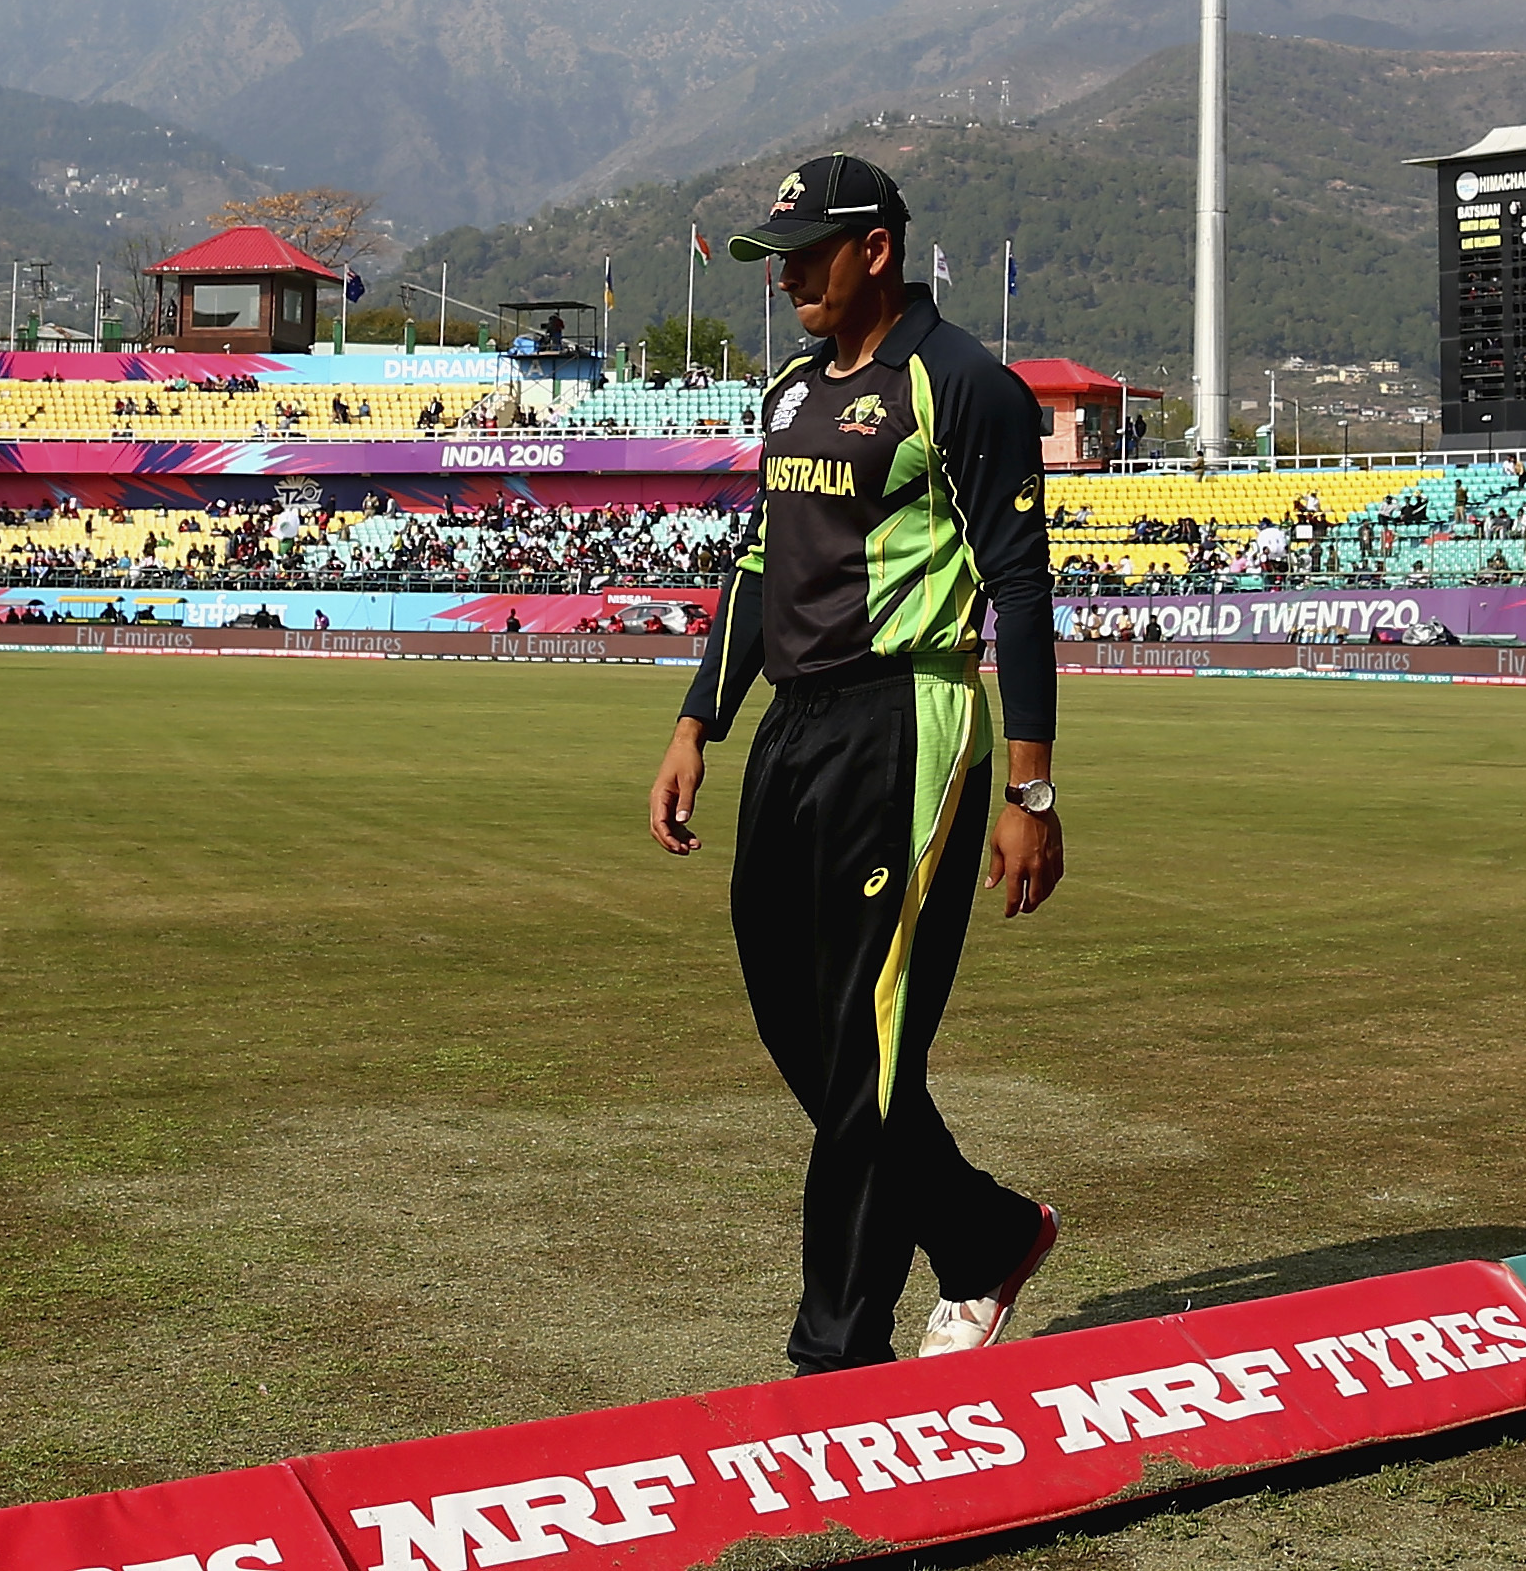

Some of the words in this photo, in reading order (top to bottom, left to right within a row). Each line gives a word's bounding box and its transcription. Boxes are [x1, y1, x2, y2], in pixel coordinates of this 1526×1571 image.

[1457, 203, 1501, 219] BATSMAN
[384, 359, 543, 378] DHARAMSAA
[441, 445, 506, 467] INDIA
[509, 444, 565, 466] 2016
[607, 594, 652, 604] NISSAN
[1130, 605, 1242, 637] WORLD
[1251, 600, 1419, 636] TWENTY20
[115, 628, 193, 647] Emirates
[321, 632, 401, 651] Emirates
[491, 634, 519, 656] Fly
[527, 635, 605, 655] Emirates
[1096, 644, 1125, 667] Fly
[1133, 645, 1210, 667] Emirates
[1297, 646, 1326, 669] Fly
[1332, 647, 1410, 670] Emirates
[1498, 649, 1526, 676] Fly
[350, 1454, 697, 1571] MRF
[707, 1401, 1027, 1515] TYRES
[1032, 1348, 1291, 1455] MRF
